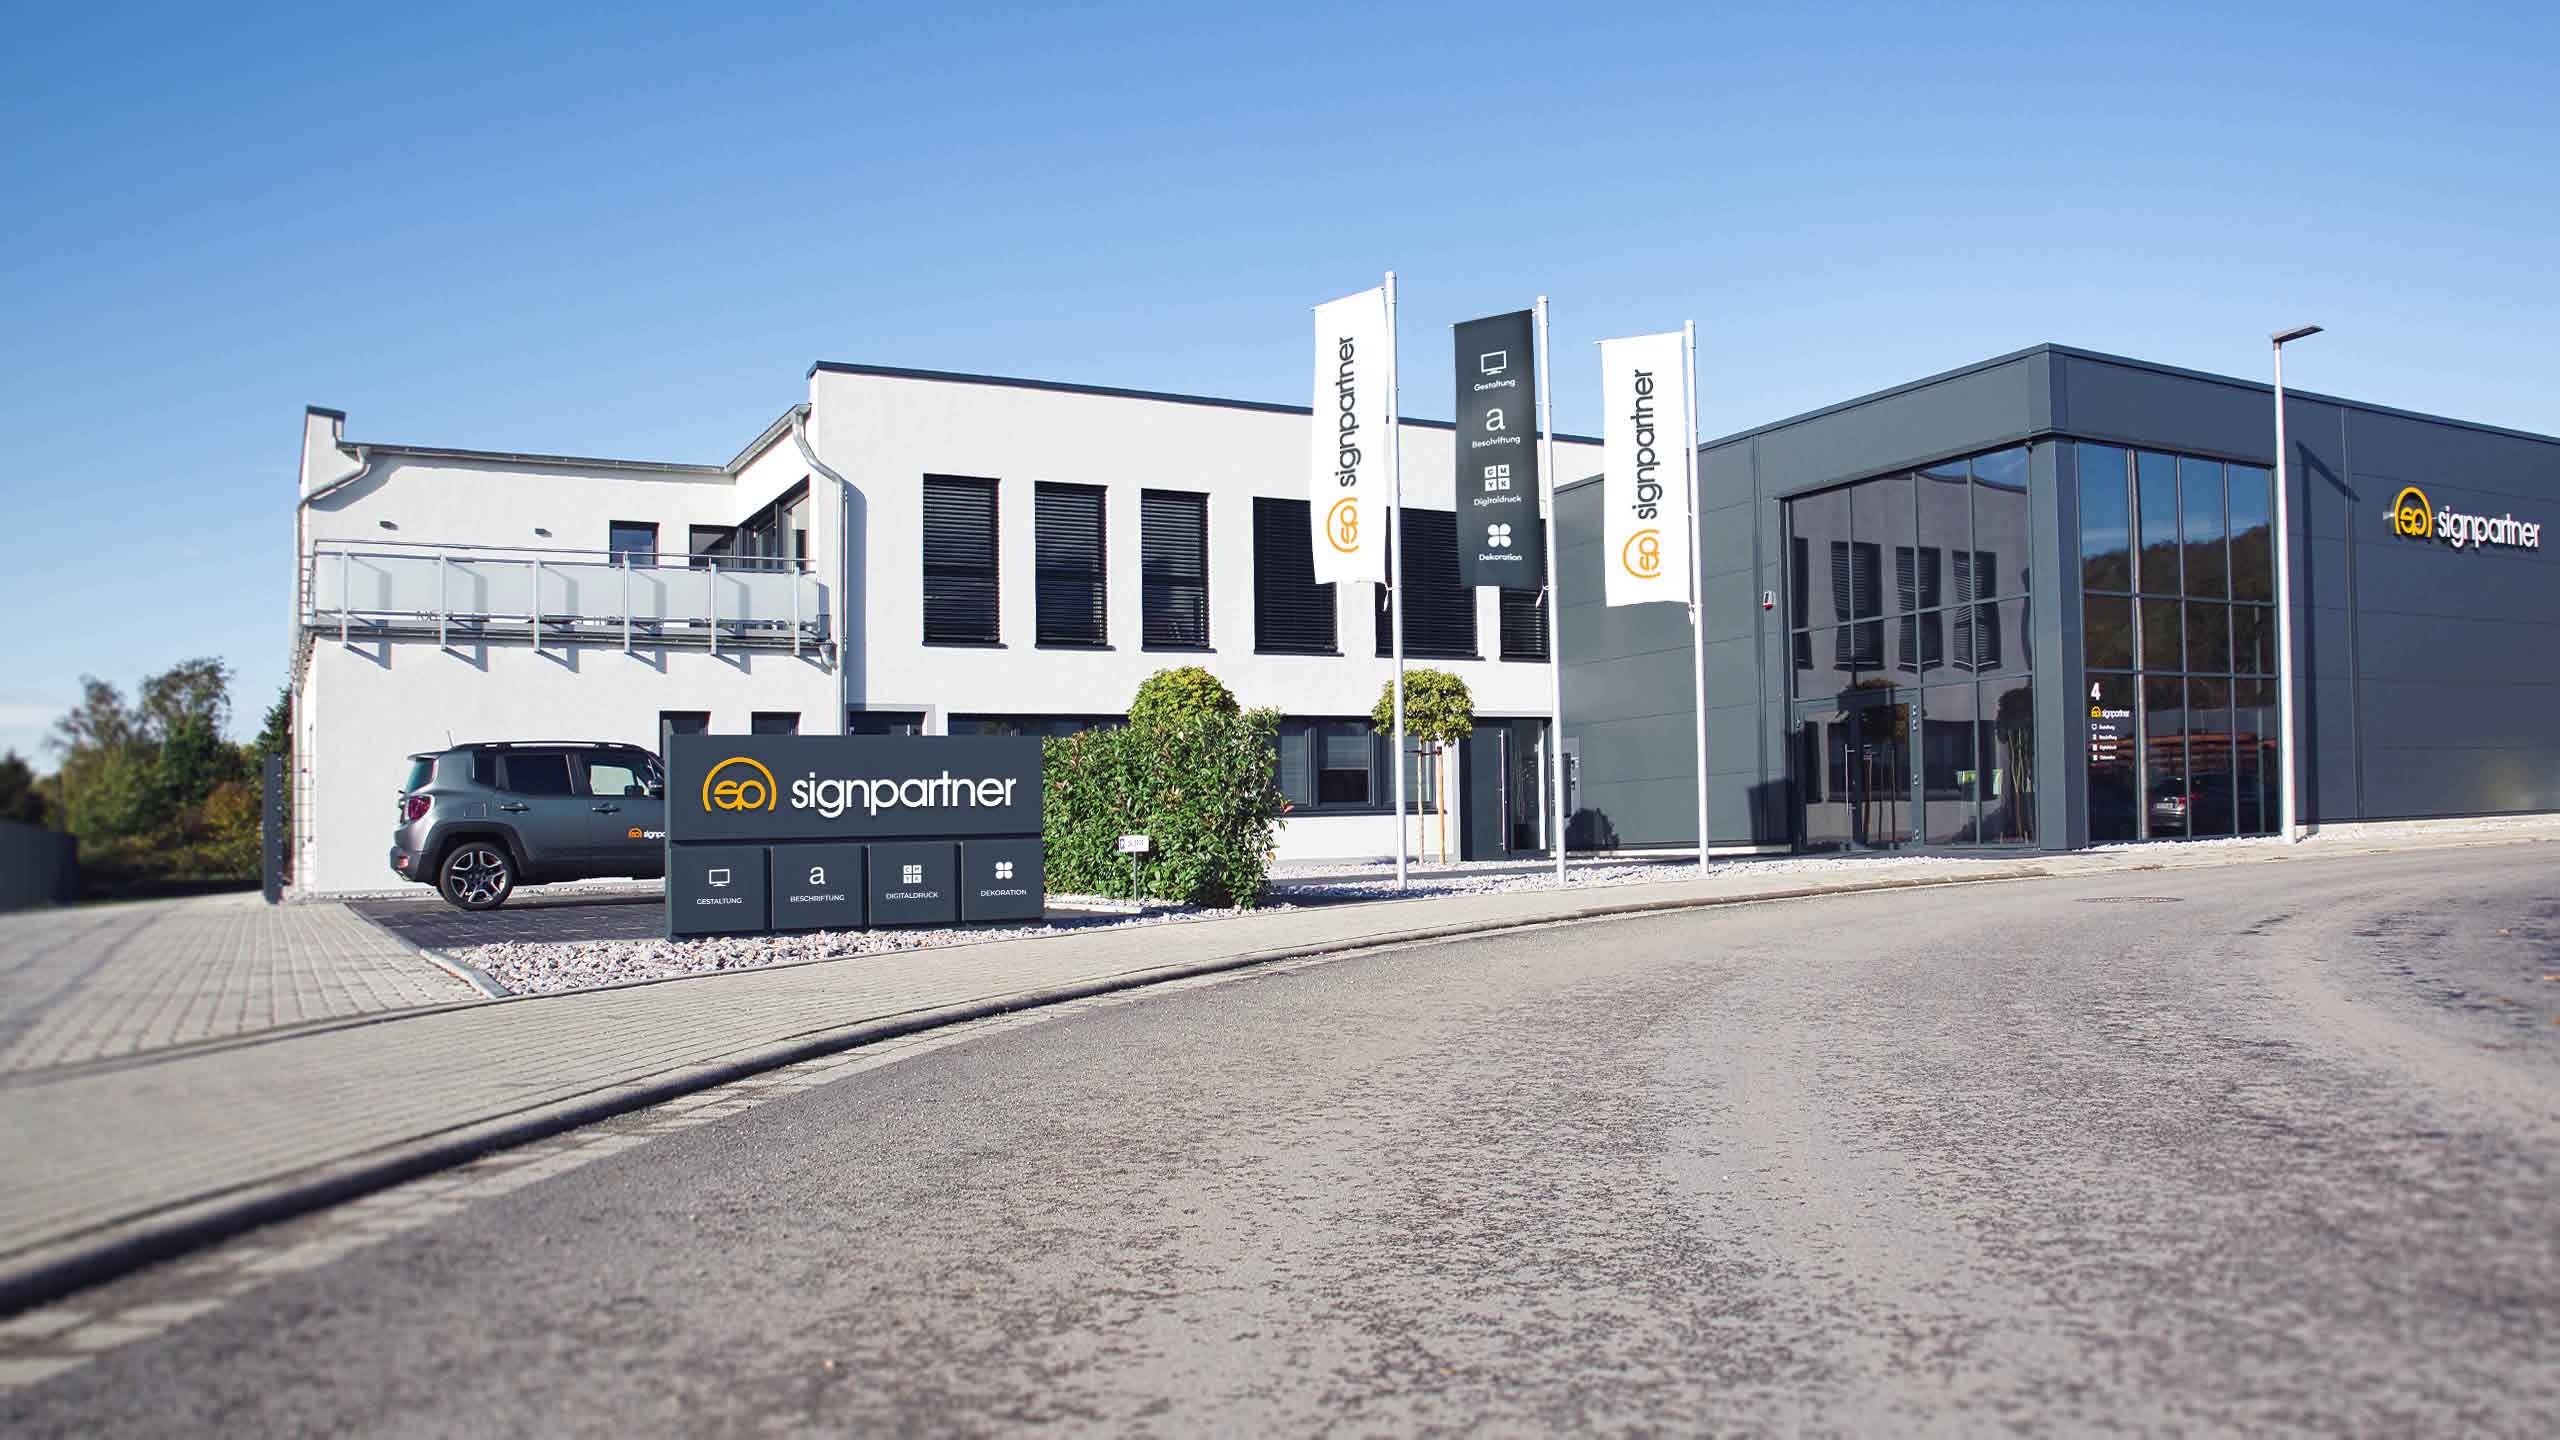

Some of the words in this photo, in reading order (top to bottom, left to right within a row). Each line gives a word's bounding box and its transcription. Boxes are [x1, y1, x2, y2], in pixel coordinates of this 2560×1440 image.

[1473, 379, 1516, 392] Gestaltung
[1335, 337, 1361, 487] signpartner
[1472, 436, 1521, 449] Beschriftung
[1630, 369, 1663, 519] signpartner
[1473, 496, 1522, 507] Digitaldruck
[2438, 505, 2541, 549] signpartner
[1479, 553, 1522, 561] Dekoration
[2090, 682, 2101, 701] 4
[791, 770, 1017, 818] signpartner
[790, 894, 845, 903] BESCHRIFTUNG
[885, 891, 938, 900] DIGITALDRUCK
[980, 889, 1027, 897] DEKORATION
[696, 897, 742, 905] GESTALTUNG
